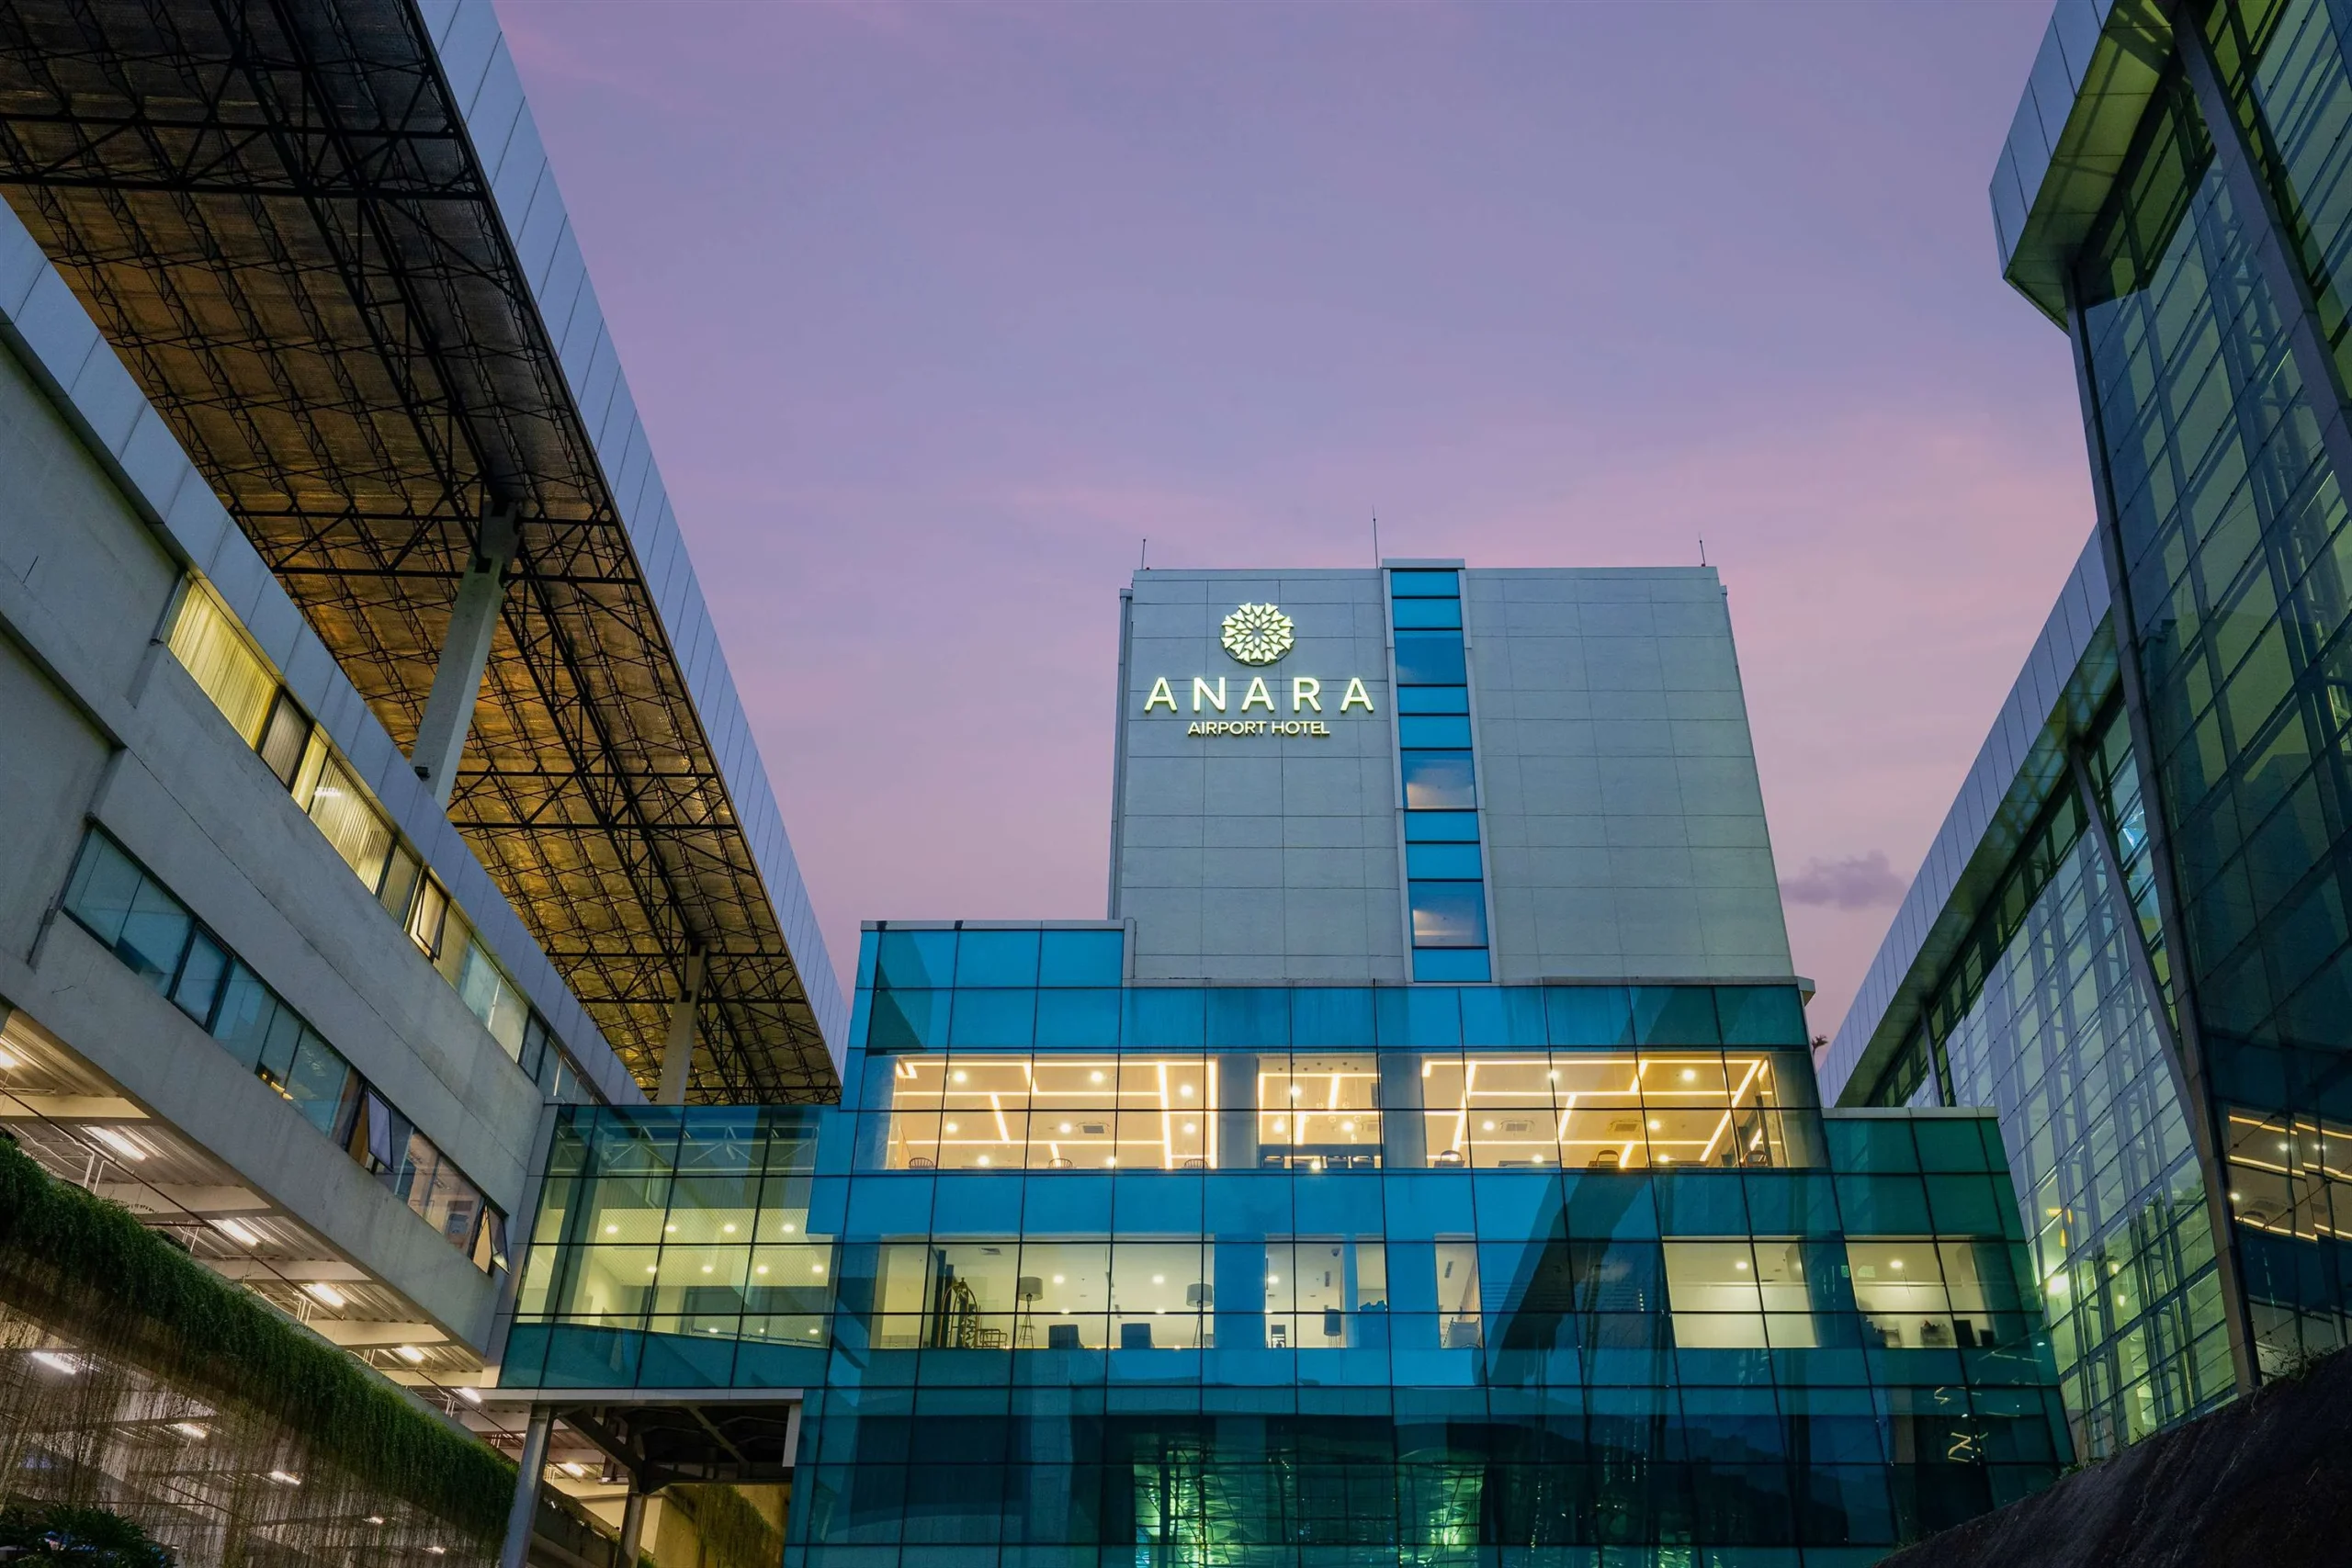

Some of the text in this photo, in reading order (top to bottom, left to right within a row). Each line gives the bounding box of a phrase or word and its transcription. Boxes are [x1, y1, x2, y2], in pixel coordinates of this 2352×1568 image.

[1144, 676, 1374, 714] ANARA
[1187, 720, 1330, 737] AIRPORT HOTEL
